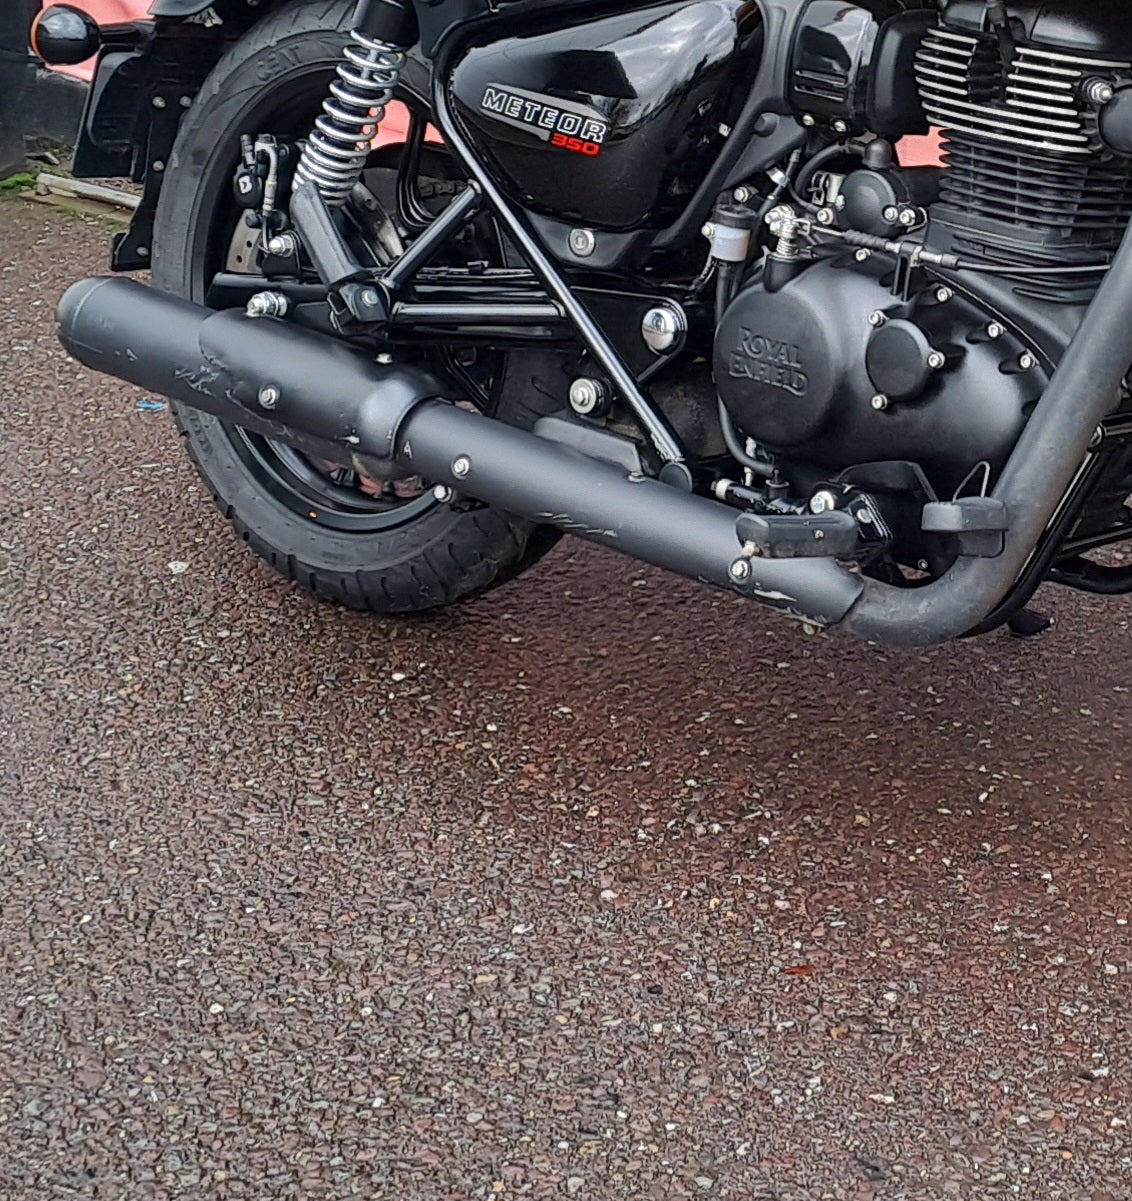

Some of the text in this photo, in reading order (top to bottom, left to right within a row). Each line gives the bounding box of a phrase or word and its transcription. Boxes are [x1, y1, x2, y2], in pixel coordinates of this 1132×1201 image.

[481, 88, 607, 143] METEOR
[550, 132, 600, 156] 350
[736, 326, 803, 369] ROYAL
[728, 351, 809, 397] ENFIELD
